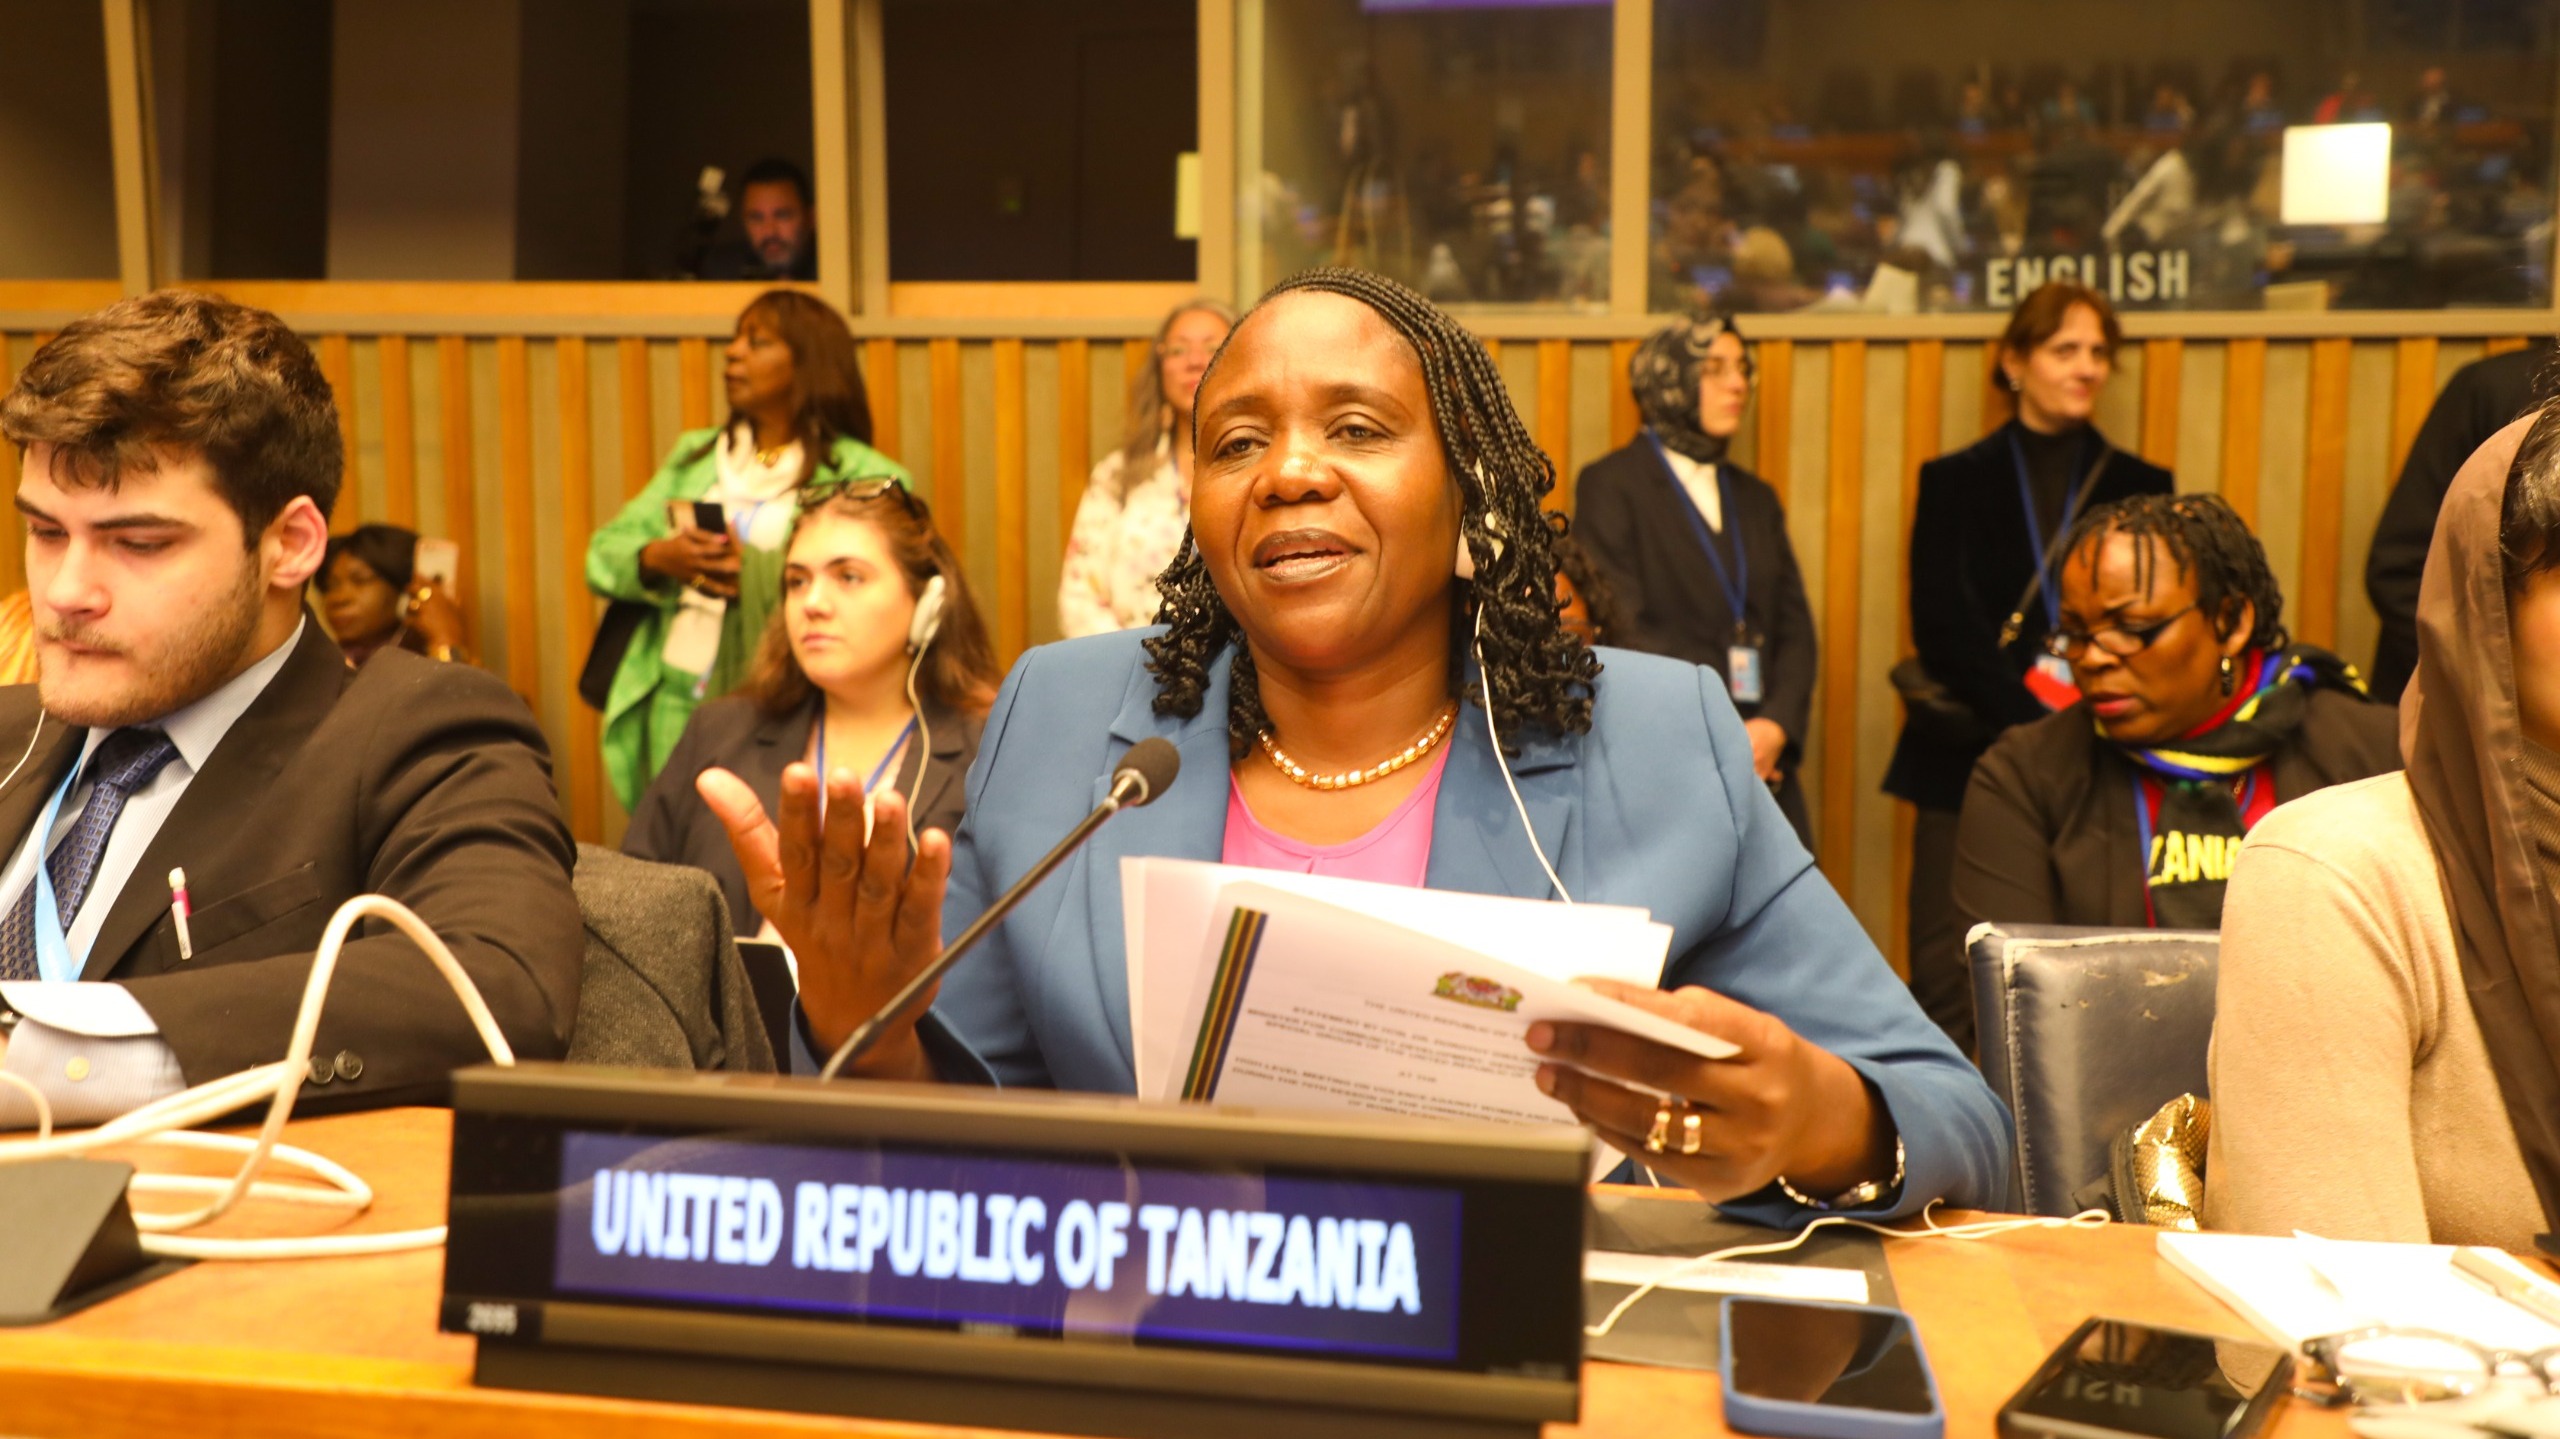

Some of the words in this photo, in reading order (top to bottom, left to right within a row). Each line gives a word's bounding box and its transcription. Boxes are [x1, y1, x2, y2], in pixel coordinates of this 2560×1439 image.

[592, 1168, 784, 1267] UNITED
[792, 1182, 1047, 1286] REPUBLIC
[1054, 1200, 1131, 1292] OF
[1138, 1206, 1422, 1315] TANZANIA
